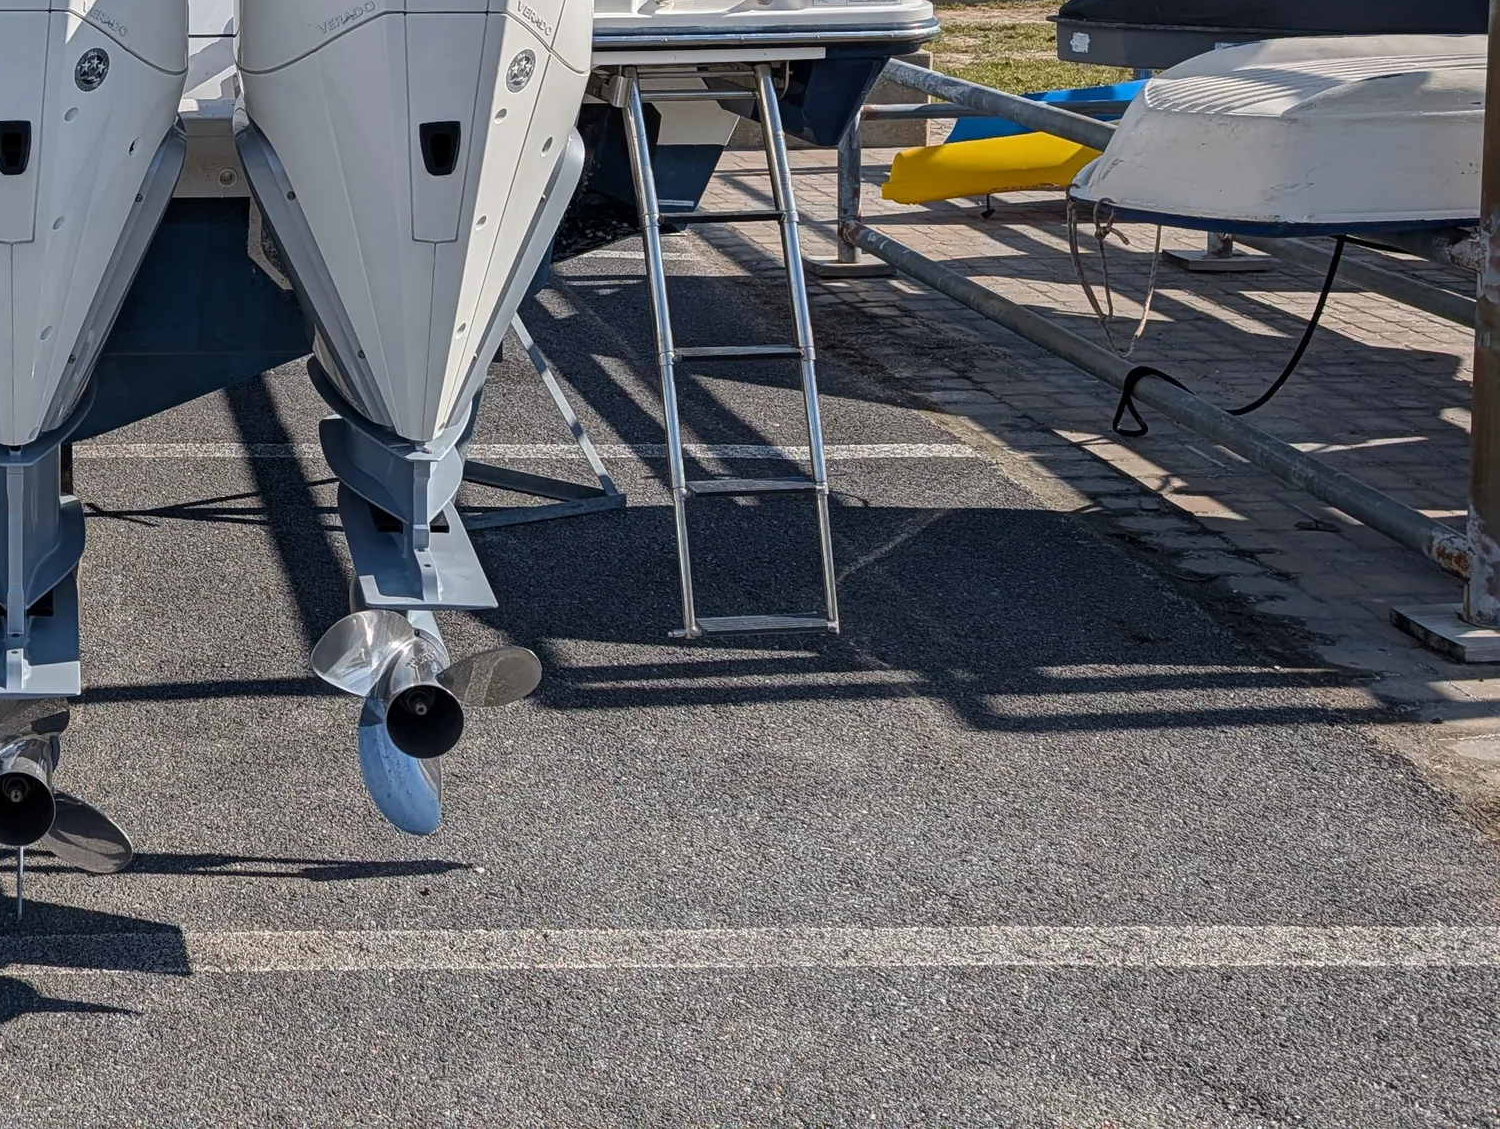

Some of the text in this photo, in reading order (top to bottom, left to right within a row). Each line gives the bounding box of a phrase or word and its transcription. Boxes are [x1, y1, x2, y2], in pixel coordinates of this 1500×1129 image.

[83, 1, 128, 37] VERADO
[317, 0, 376, 34] VERADO
[517, 0, 552, 36] VERADO
